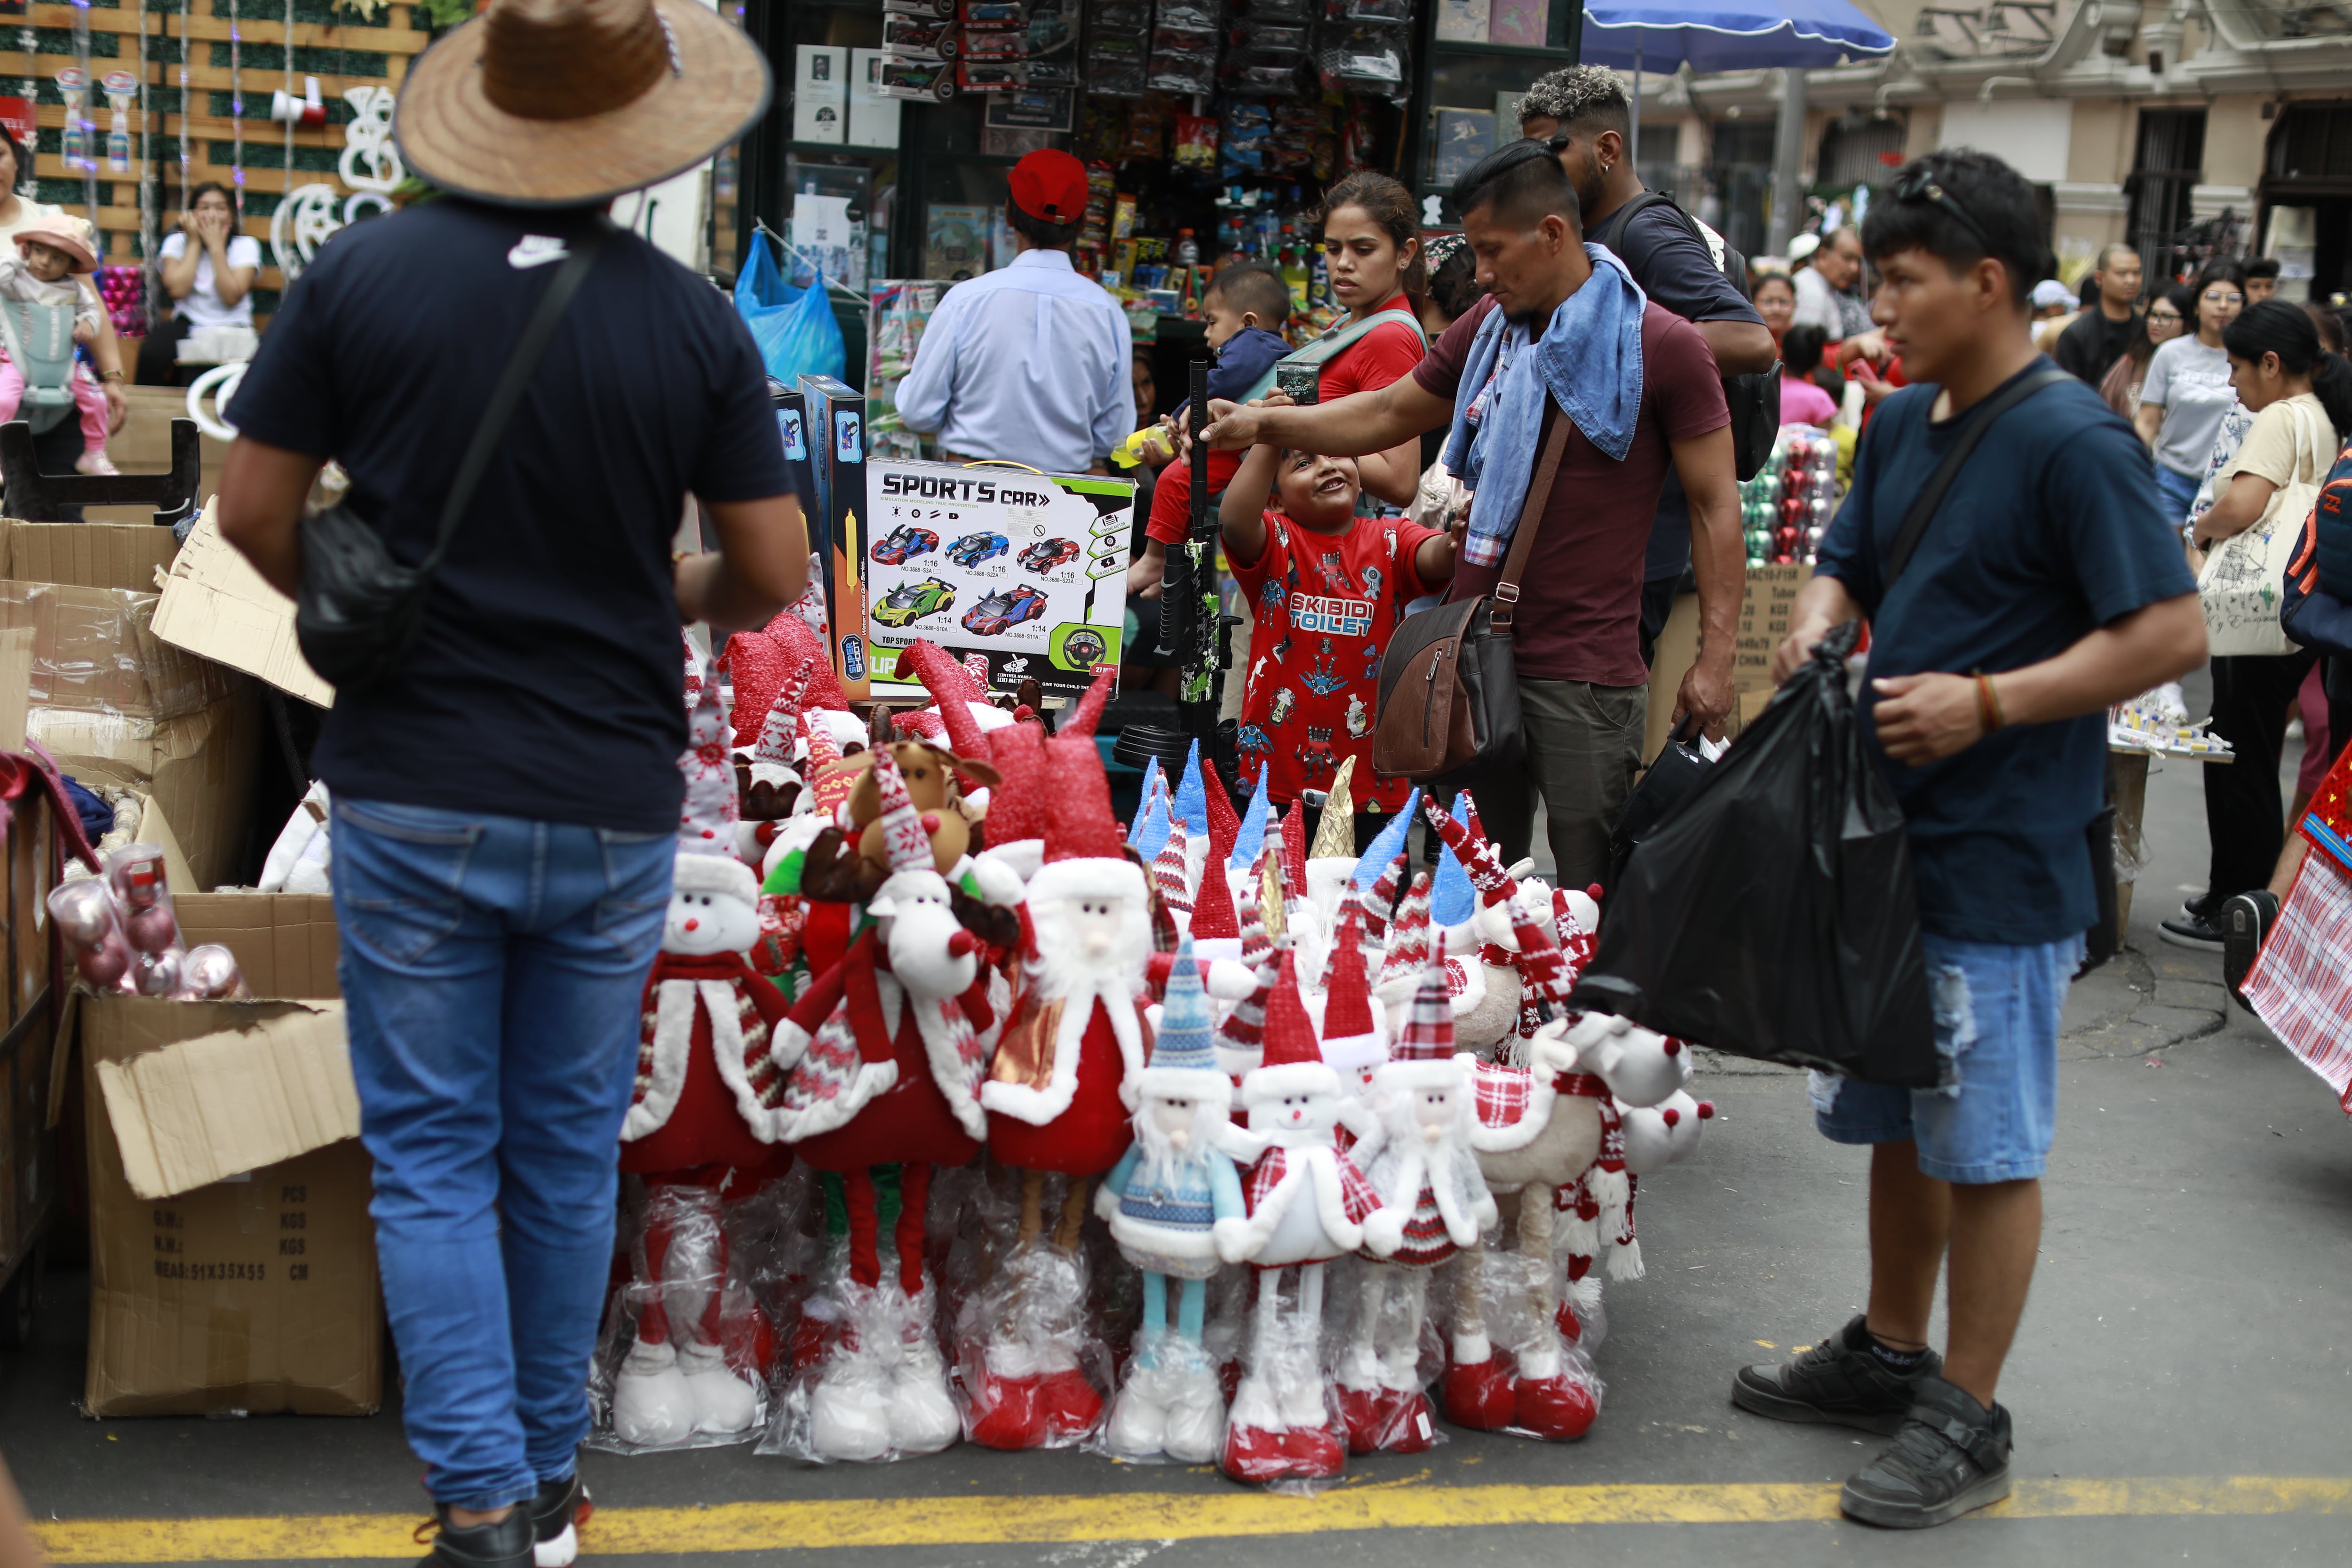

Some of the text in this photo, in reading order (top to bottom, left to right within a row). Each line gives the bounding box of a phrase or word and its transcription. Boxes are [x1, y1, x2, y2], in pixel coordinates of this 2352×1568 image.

[1283, 383, 1311, 392] SHOOTING
[881, 473, 1037, 507] SPORTS CAR
[1290, 593, 1372, 619] SKIBIDI
[1290, 610, 1372, 635] TOILET
[896, 637, 917, 645] SPORT
[846, 641, 857, 674] SUPER
[852, 640, 863, 672] SHOOT
[283, 1186, 306, 1203] PCS
[154, 1210, 306, 1230] G.W.: KGS
[154, 1234, 306, 1256] N.W.: KGS
[290, 1264, 308, 1281] CM
